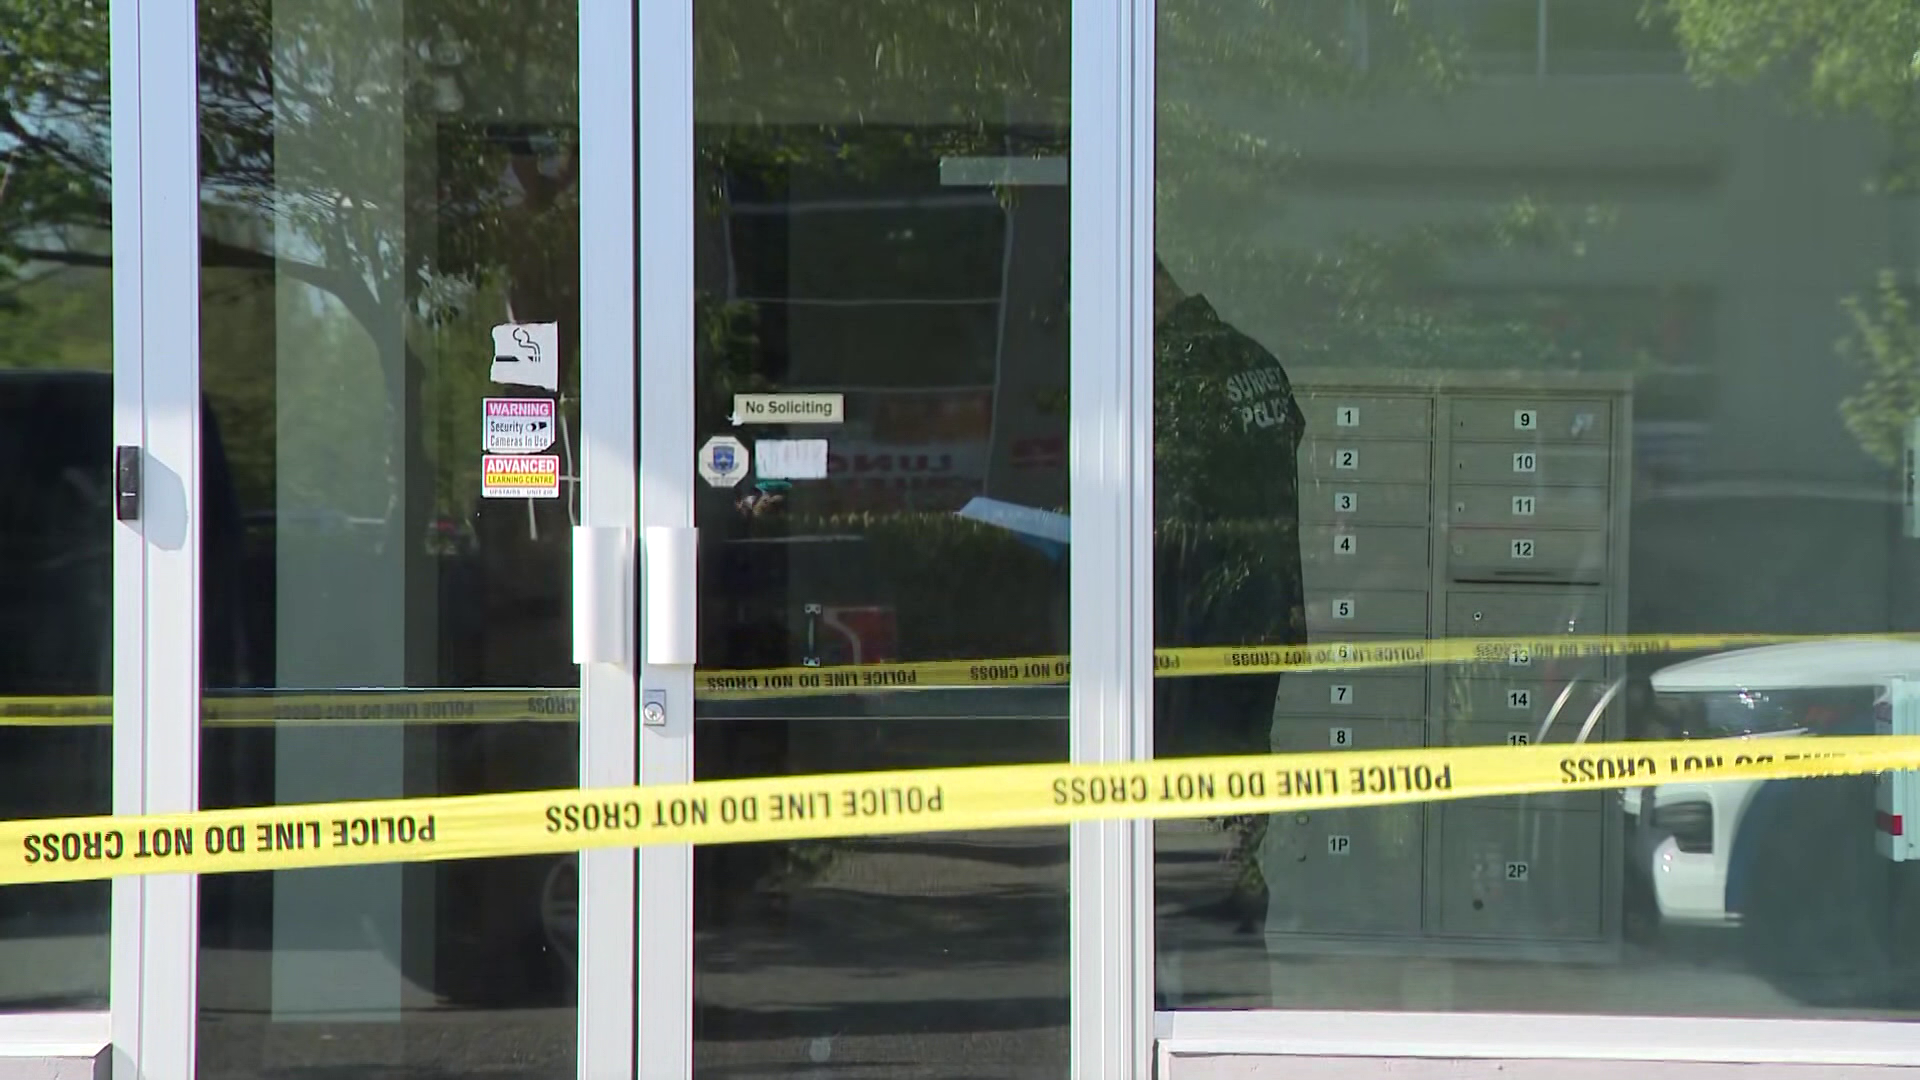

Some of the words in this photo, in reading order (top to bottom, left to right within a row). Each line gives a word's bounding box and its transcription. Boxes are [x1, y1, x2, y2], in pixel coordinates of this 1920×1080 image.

[489, 402, 549, 416] WARNING
[746, 401, 764, 413] No
[768, 401, 833, 417] Soliciting
[1343, 409, 1352, 424] 1
[1519, 412, 1530, 427] 9
[490, 421, 523, 434] Security
[490, 435, 522, 447] Cameras
[534, 435, 548, 447] Use
[487, 460, 555, 473] ADVANCED
[1342, 451, 1352, 467] 2
[1515, 454, 1533, 470] 10
[488, 476, 524, 484] LEARNING
[525, 476, 553, 484] CENTRE
[1341, 494, 1351, 510] 3
[1515, 498, 1531, 513] 11
[1340, 536, 1350, 551] 4
[1514, 540, 1531, 556] 12
[1339, 601, 1349, 616] 5
[1339, 646, 1347, 658] 6
[863, 669, 917, 685] POLICE
[970, 666, 1018, 680] CROSS
[1025, 664, 1049, 678] NOT
[764, 675, 792, 689] NOT
[799, 673, 820, 687] DO
[825, 672, 858, 686] LINE
[1338, 688, 1347, 701] 7
[1511, 692, 1528, 707] 14
[1337, 729, 1346, 744] 8
[1510, 734, 1528, 747] 15
[1227, 770, 1266, 799] DO
[1277, 768, 1339, 797] LINE
[1350, 762, 1453, 794] POLICE
[1052, 776, 1148, 806] CROSS
[1159, 773, 1216, 801] NOT
[769, 791, 831, 820] LINE
[842, 785, 944, 816] POLICE
[652, 798, 709, 828] NOT
[720, 795, 758, 823] DO
[545, 802, 641, 834] CROSS
[257, 820, 321, 851] LINE
[332, 814, 436, 847] POLICE
[22, 830, 124, 864] CROSS
[133, 827, 194, 858] NOT
[204, 825, 246, 855] DO
[1330, 838, 1348, 851] 1P
[1508, 864, 1527, 878] 2P
